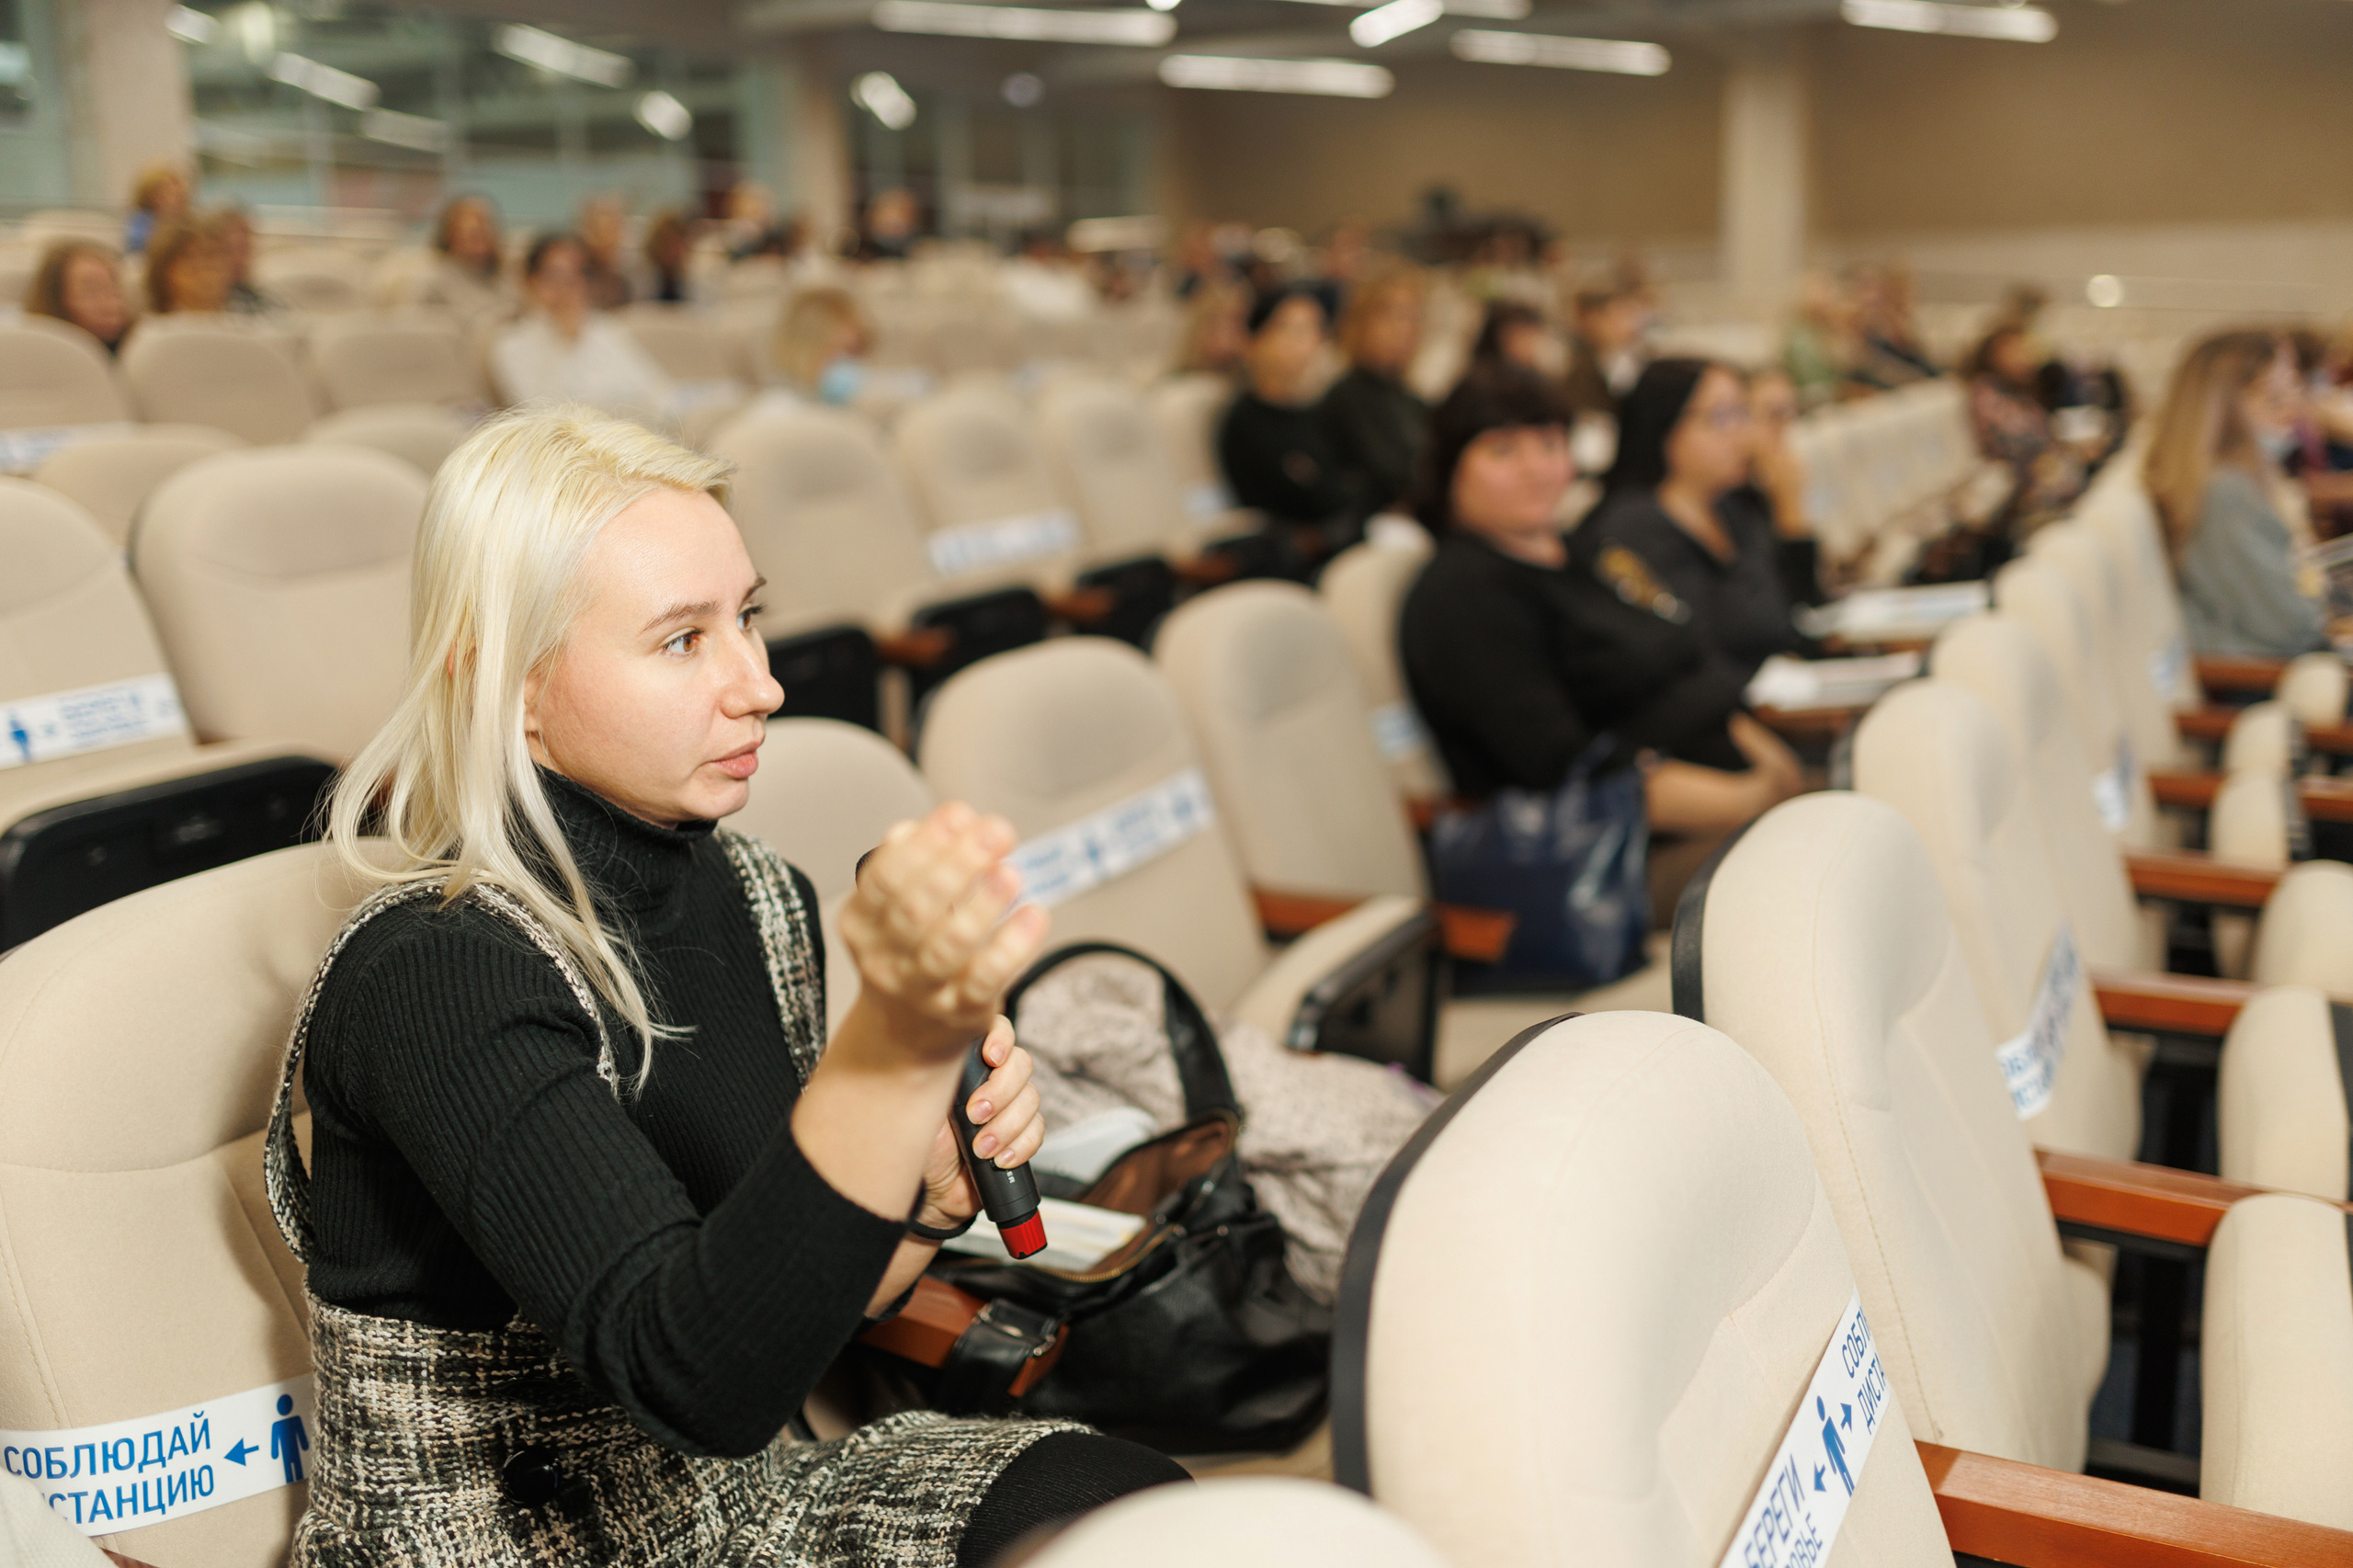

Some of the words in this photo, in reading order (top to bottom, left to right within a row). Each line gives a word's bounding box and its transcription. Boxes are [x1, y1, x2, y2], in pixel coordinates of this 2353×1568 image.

[4, 1410, 211, 1480] СОБЛЮДАЙ
[41, 1464, 215, 1525] СТАНЦИЮ
[1784, 1511, 1823, 1568] ВЬЕ
